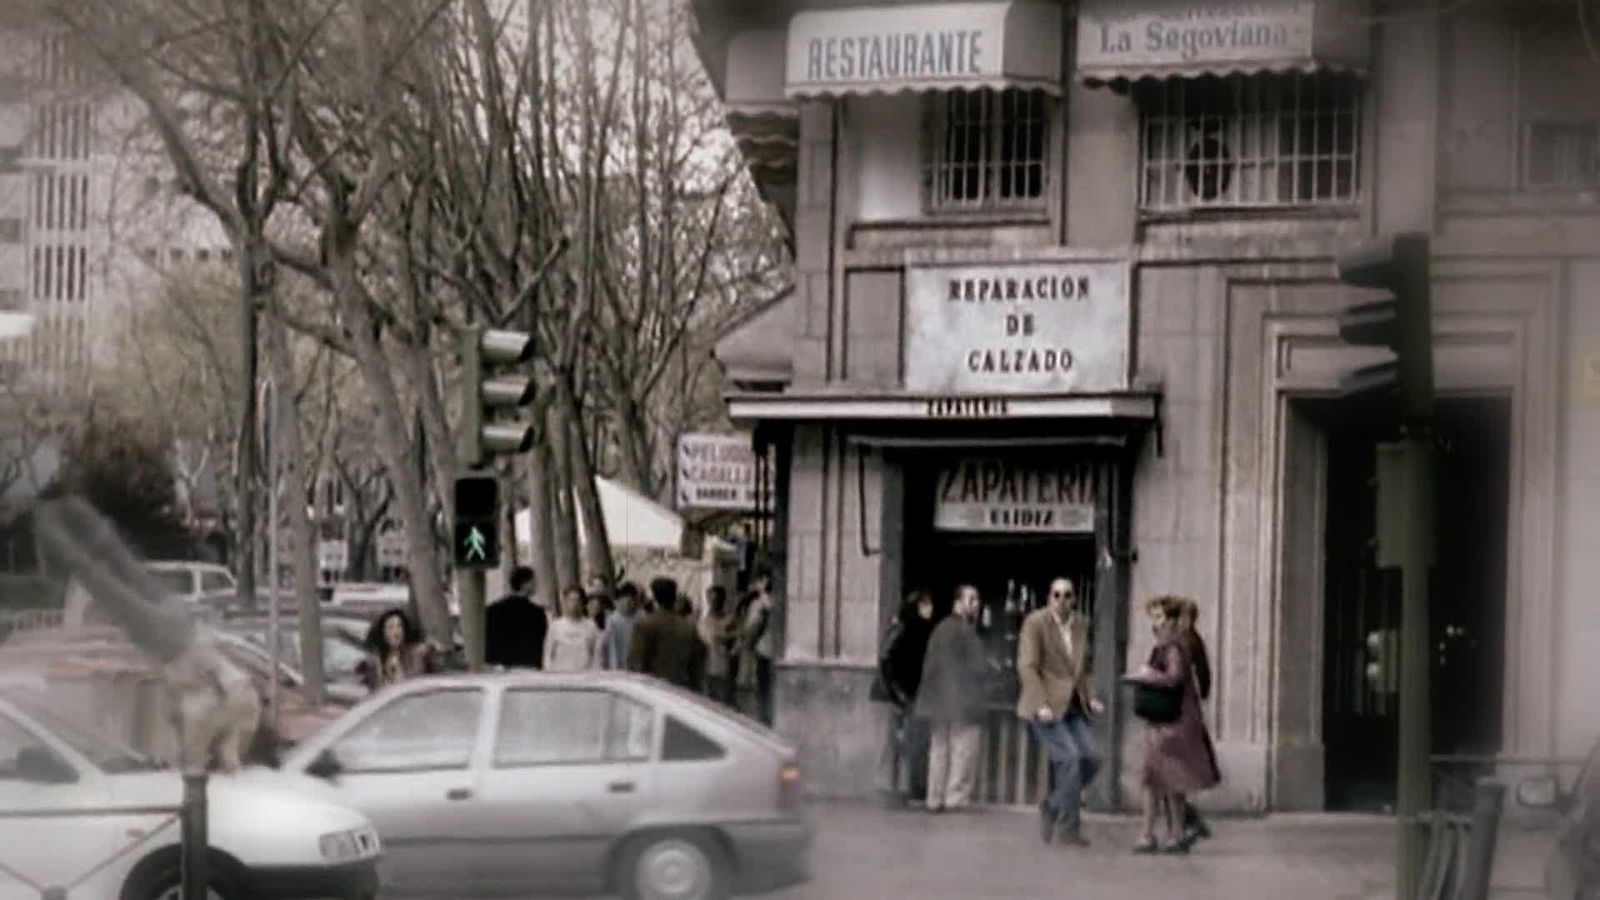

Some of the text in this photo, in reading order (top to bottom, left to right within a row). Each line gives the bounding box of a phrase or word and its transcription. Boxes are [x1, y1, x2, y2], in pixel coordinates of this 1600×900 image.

[1100, 19, 1288, 60] La Segoviana
[807, 30, 983, 79] RESTAURANTE
[948, 276, 1089, 302] REPARACION
[1006, 313, 1035, 337] DE
[967, 349, 1074, 373] CALZADO
